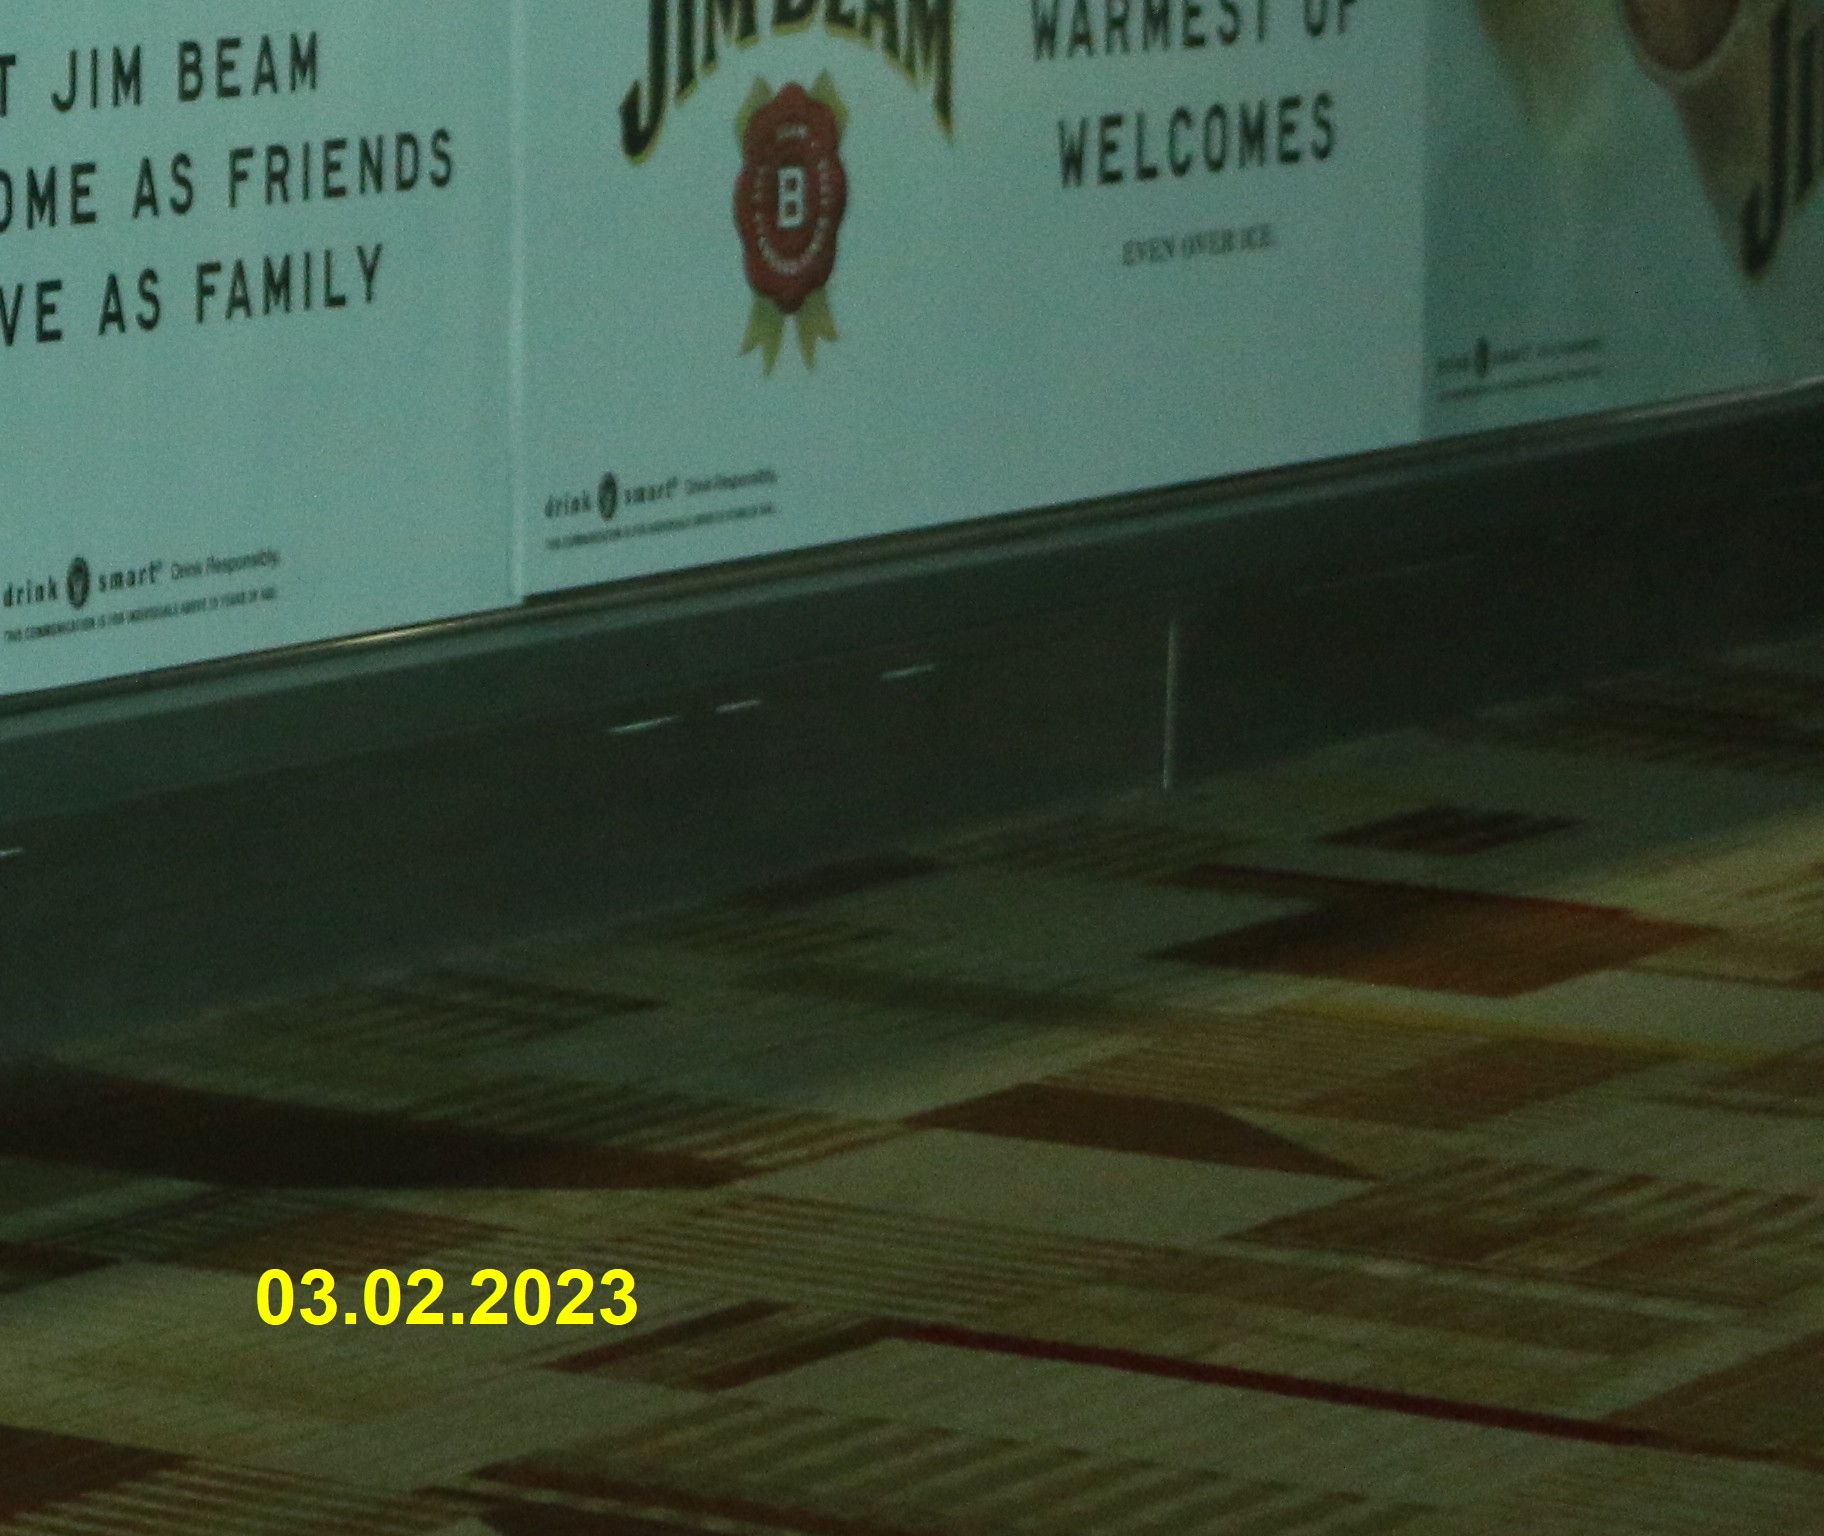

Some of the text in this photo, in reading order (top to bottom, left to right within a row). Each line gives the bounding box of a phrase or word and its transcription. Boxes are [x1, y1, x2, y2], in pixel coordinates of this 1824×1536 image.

[51, 44, 143, 113] JIM
[178, 31, 321, 102] BEAM
[132, 152, 195, 218] AS
[228, 128, 454, 209] FRIENDS
[1057, 90, 1336, 189] WELCOMES
[778, 166, 806, 228] B
[98, 268, 161, 336] AS
[195, 243, 383, 325] FAMILY
